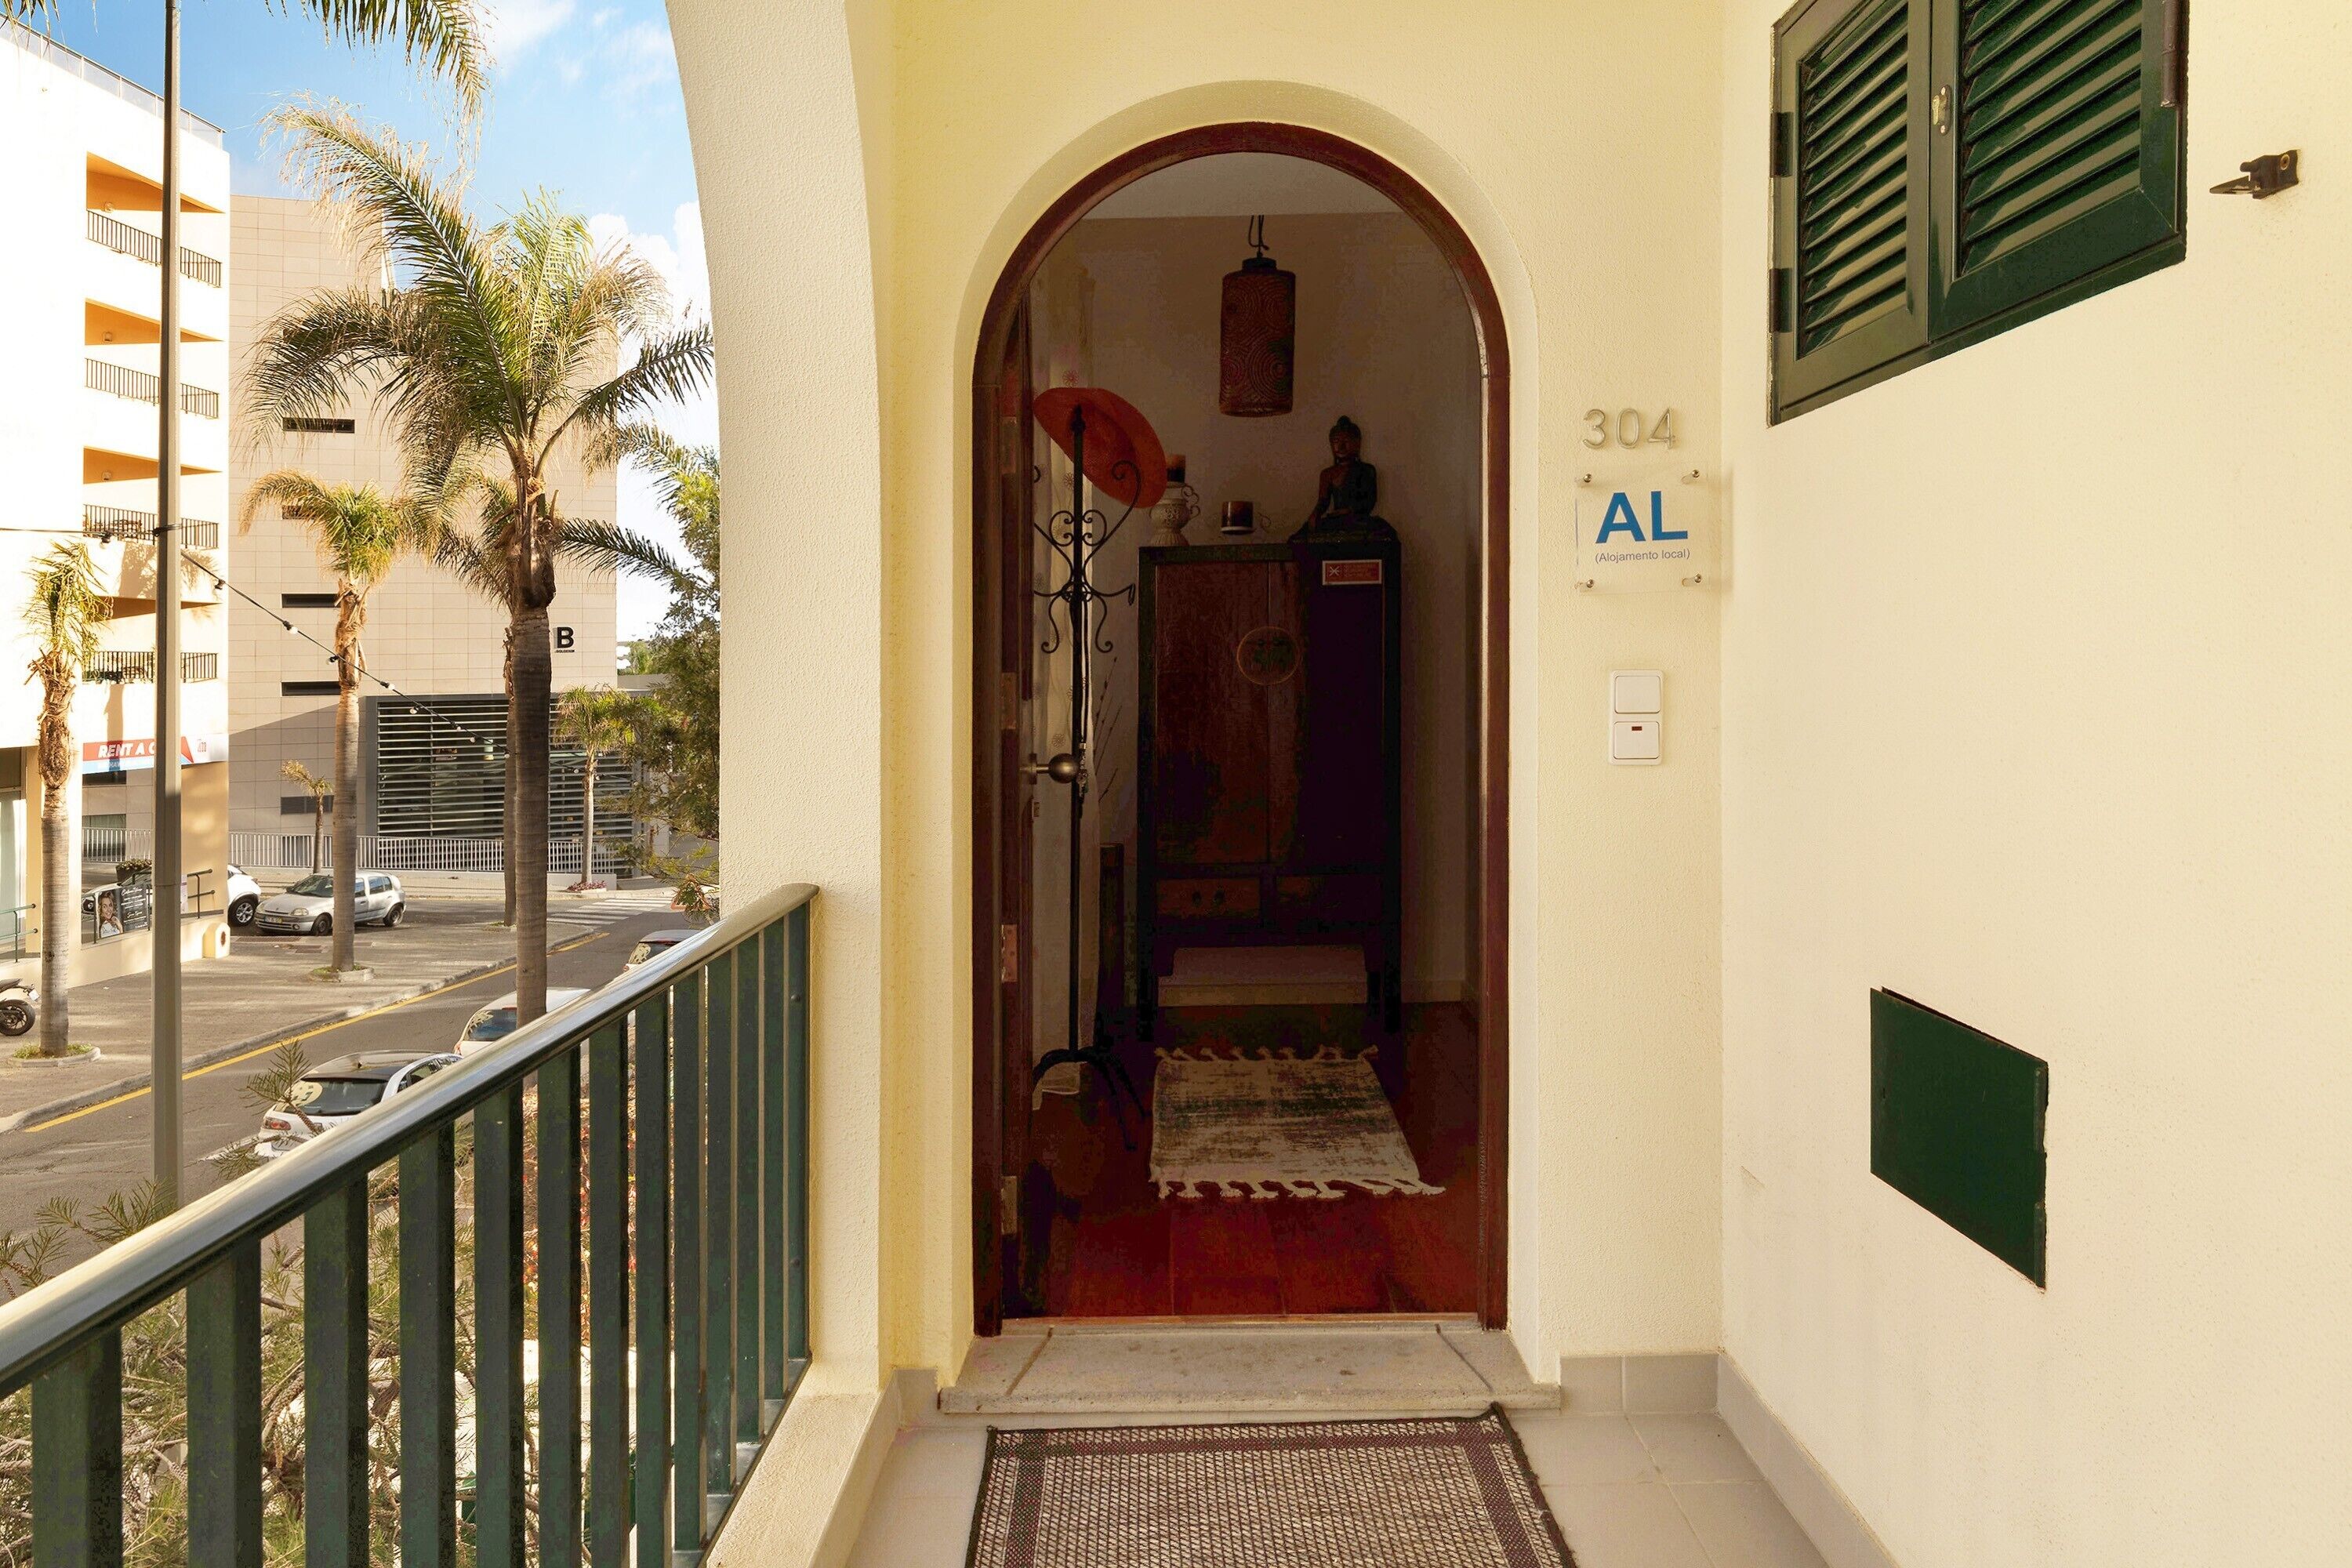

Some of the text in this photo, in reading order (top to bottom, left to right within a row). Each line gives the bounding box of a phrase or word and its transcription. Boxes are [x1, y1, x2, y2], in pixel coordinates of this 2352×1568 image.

[1583, 408, 1675, 449] 304
[1595, 491, 1688, 543] AL
[1595, 549, 1690, 564] (Alojamento local)
[557, 626, 574, 648] B
[98, 742, 133, 758] RENT
[136, 742, 145, 756] A
